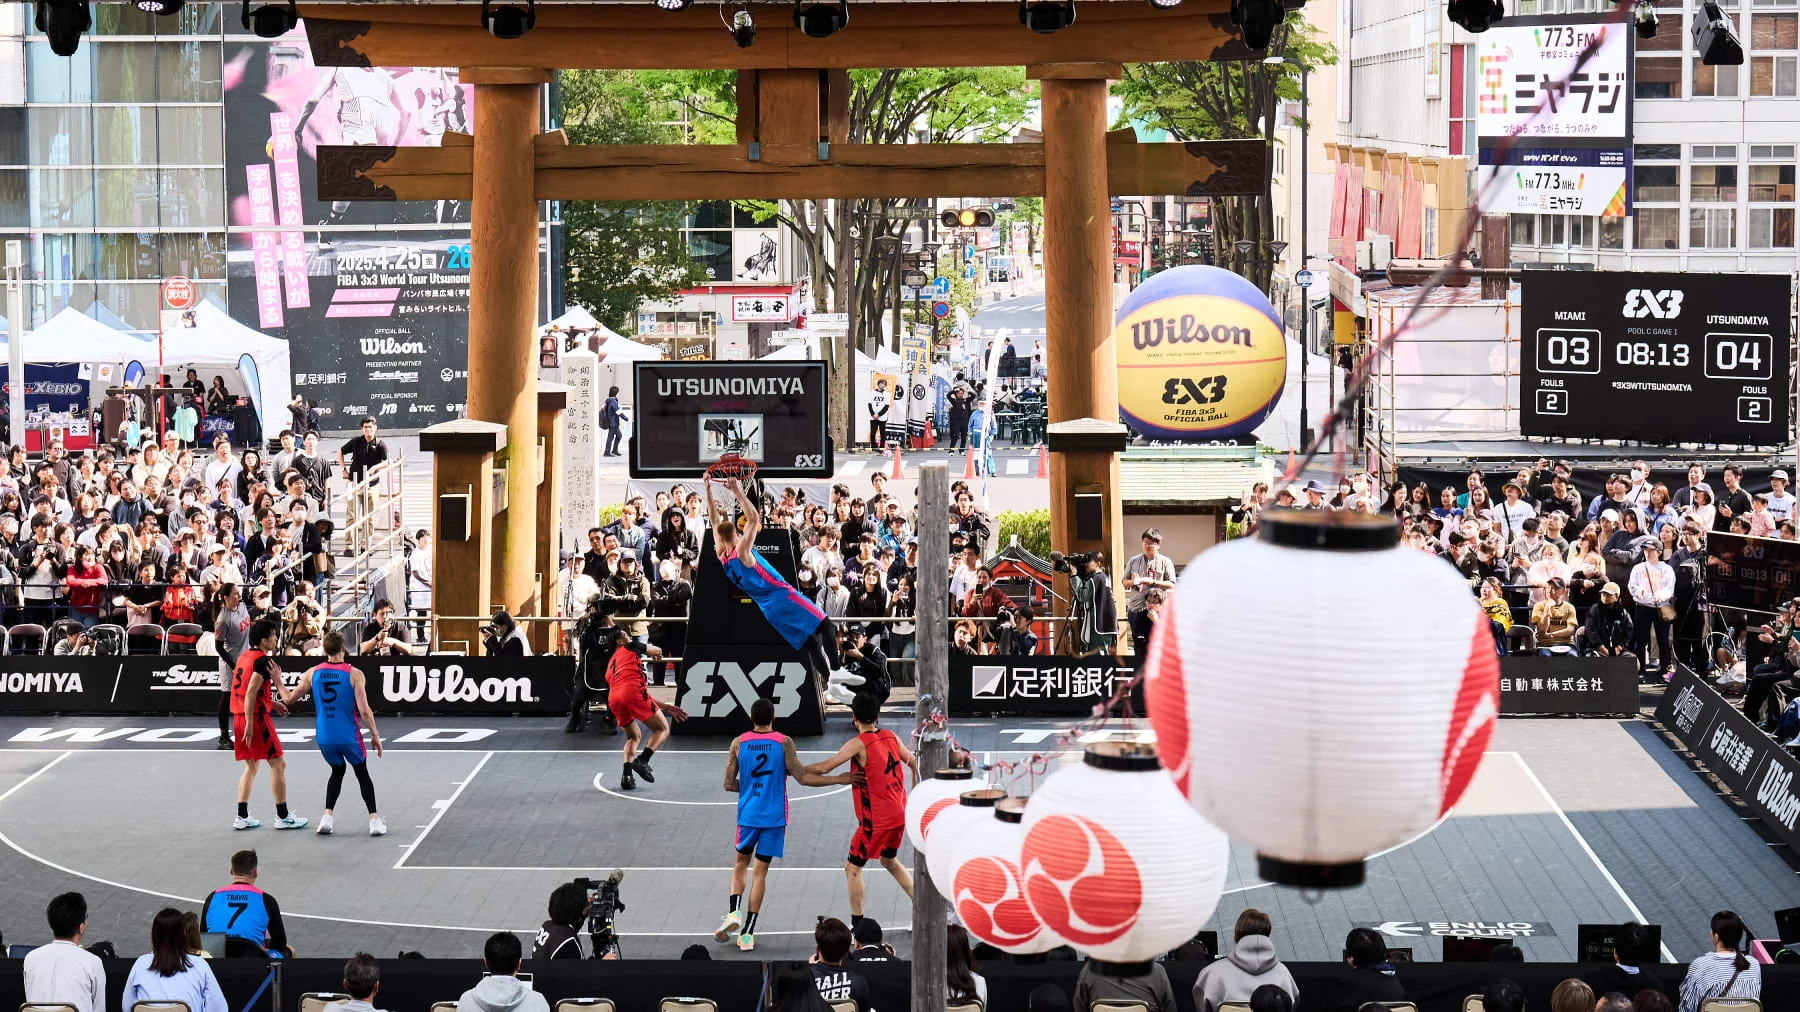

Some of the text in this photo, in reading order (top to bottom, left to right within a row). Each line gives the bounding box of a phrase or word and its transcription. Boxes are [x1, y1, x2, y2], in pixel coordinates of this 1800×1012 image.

[1545, 27, 1573, 47] 77.3
[1535, 173, 1560, 190] 77.3
[272, 113, 309, 307] 世界一を決める戦いが
[249, 167, 281, 324] 宇都宮から始まる
[337, 275, 358, 286] FIBA
[360, 274, 378, 285] 3x3
[380, 273, 405, 285] World
[408, 273, 427, 284] Tour
[1554, 311, 1586, 321] MIAMI
[1706, 315, 1769, 326] UTSUNOMIYA
[1131, 314, 1253, 350] Wilson
[1627, 327, 1645, 335] POOL
[1653, 328, 1673, 336] GAME
[360, 337, 423, 355] Wilson
[1547, 336, 1590, 365] 03
[1616, 342, 1690, 366] 08:13
[1716, 341, 1761, 371] 04
[307, 373, 347, 385] 足利銀行
[657, 377, 805, 396] UTSUNOMIYA
[1540, 379, 1564, 387] FOULS
[1742, 386, 1768, 394] FOULS
[379, 403, 398, 416] JTB
[416, 405, 436, 413] TKC
[1546, 394, 1558, 410] 2
[1748, 401, 1761, 418] 2
[1164, 412, 1229, 422] OFFICIAL BALL
[165, 665, 220, 684] SUPE
[234, 667, 244, 689] 3
[1009, 666, 1135, 699] 足利銀行
[320, 681, 341, 703] 5
[380, 665, 534, 703] Wilson
[1500, 677, 1604, 692] 自動車株式会社
[751, 753, 772, 778] 2
[227, 902, 249, 930] 7
